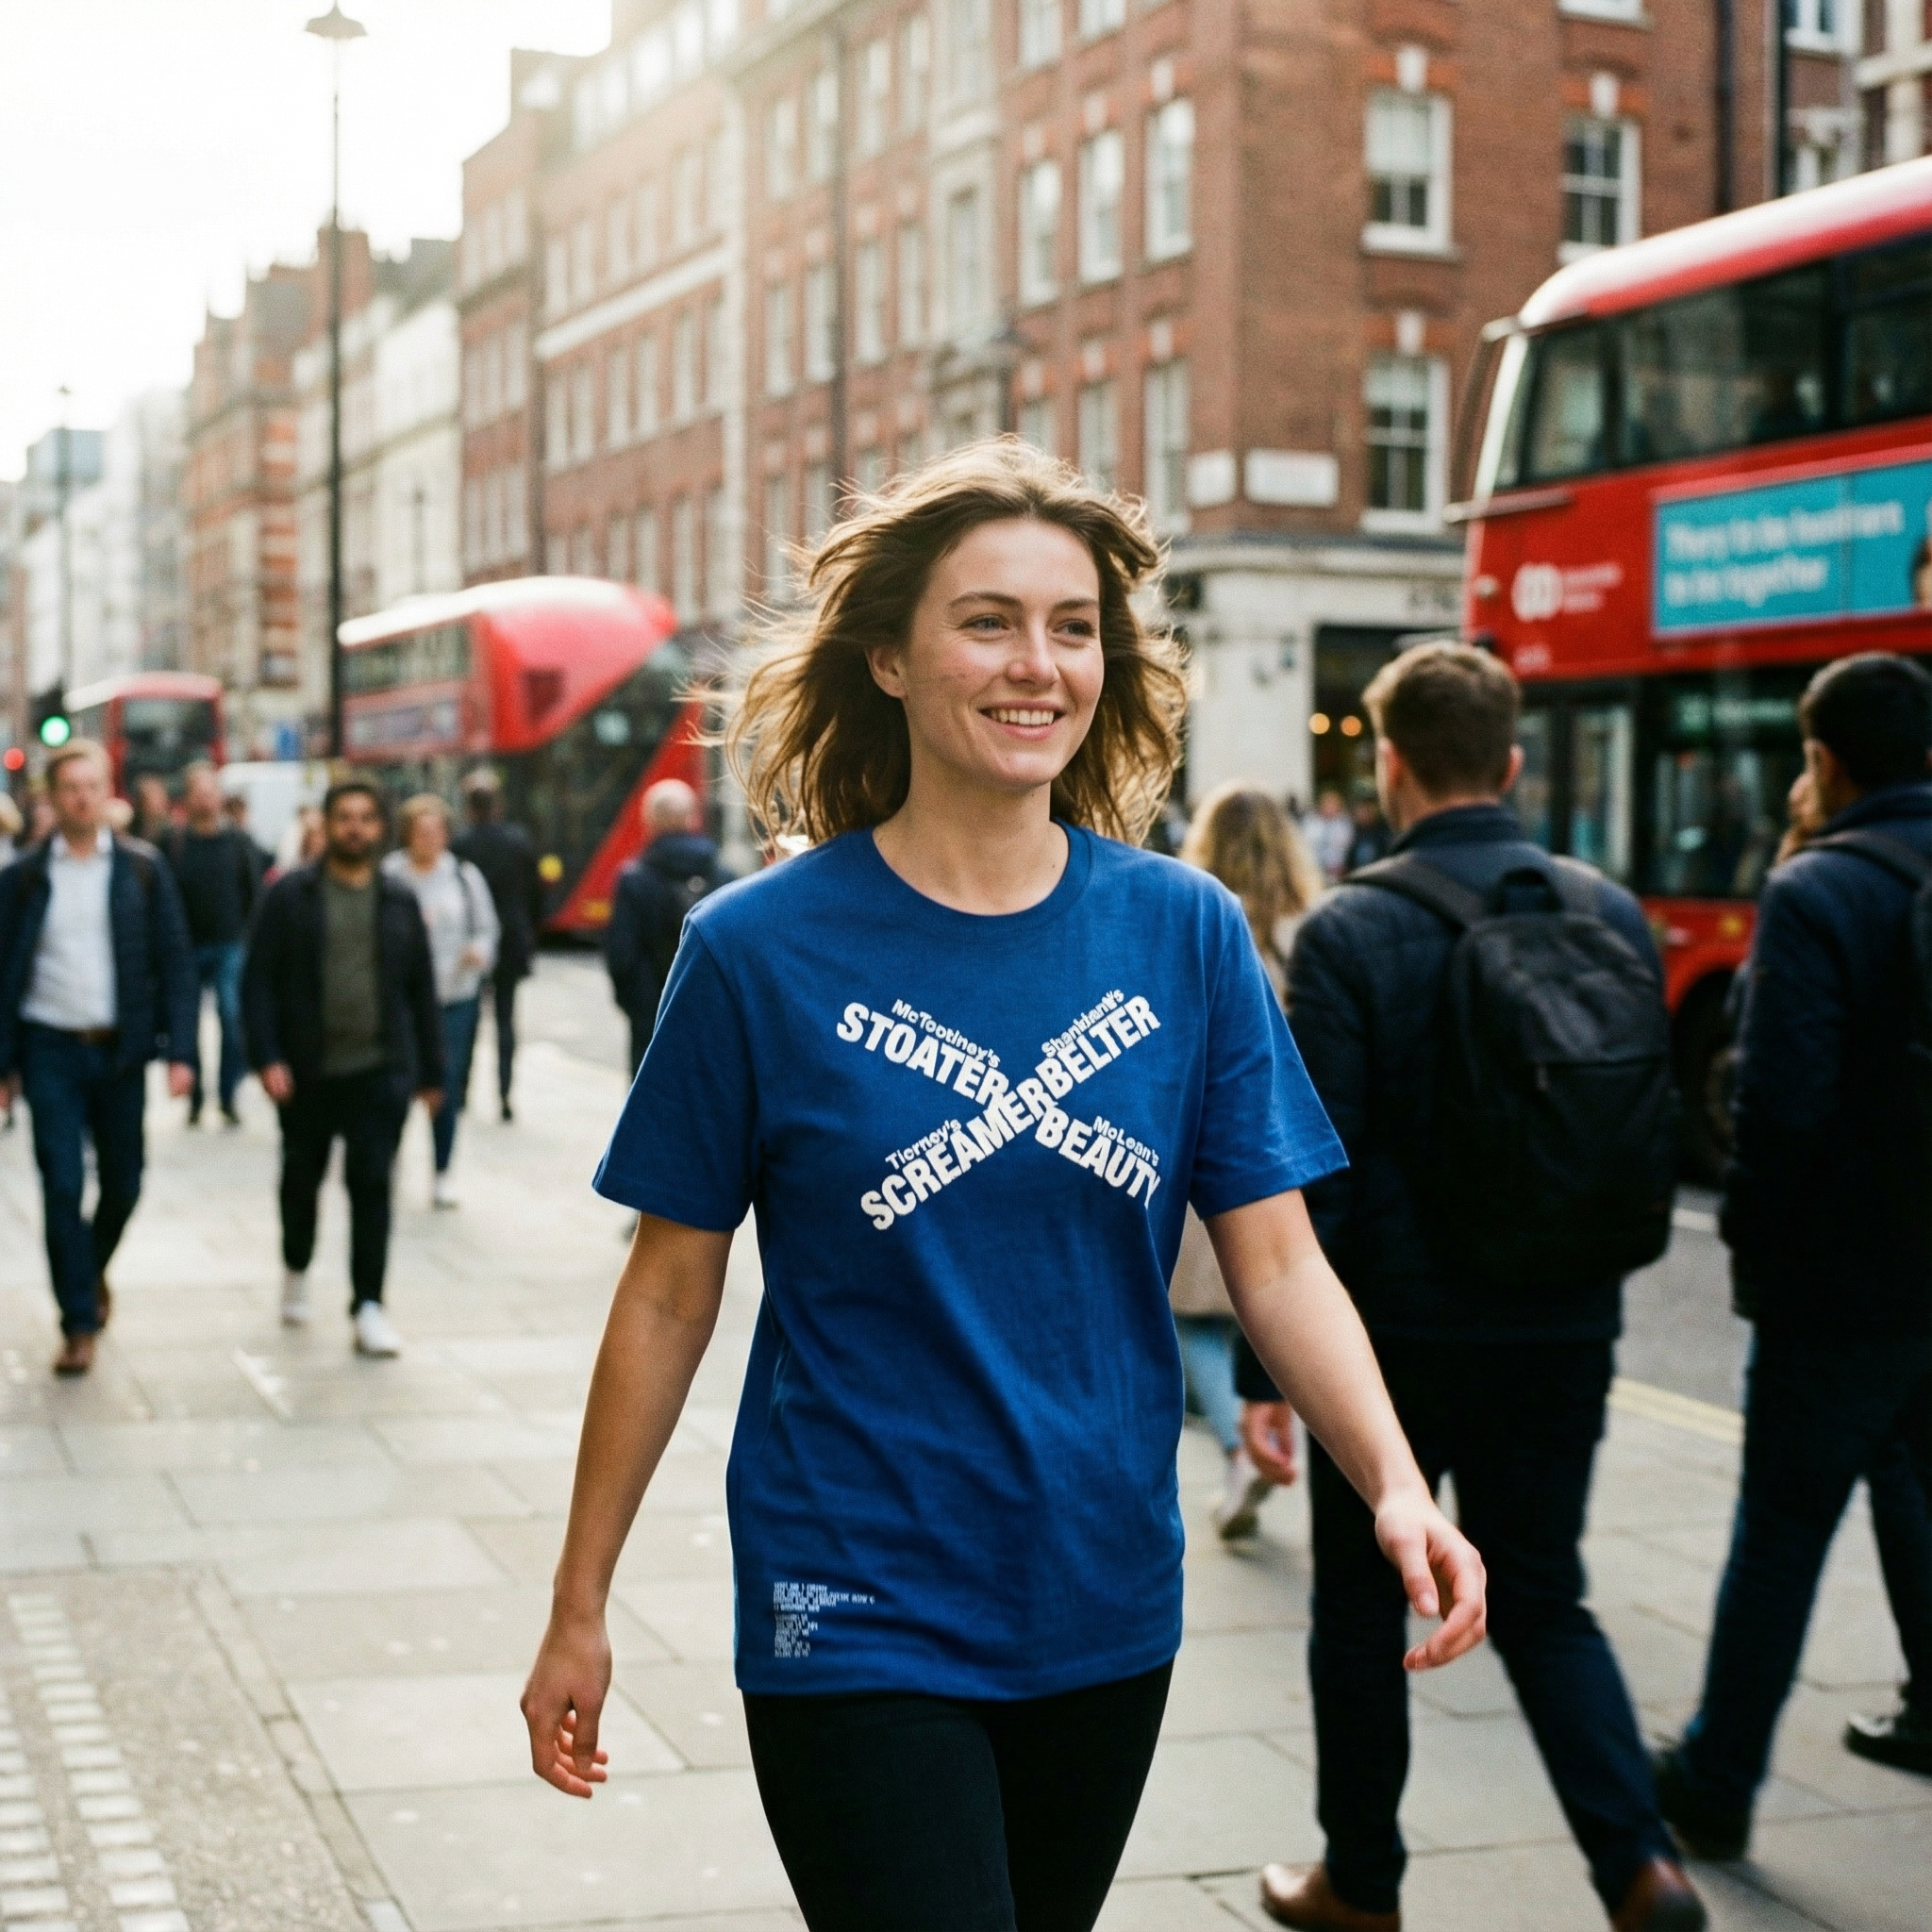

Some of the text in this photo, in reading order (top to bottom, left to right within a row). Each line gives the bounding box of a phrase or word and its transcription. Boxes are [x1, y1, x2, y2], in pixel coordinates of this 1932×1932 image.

[837, 1002, 1009, 1109] STOATER
[1035, 995, 1161, 1099] BELTER
[860, 1077, 1058, 1230] SCREAMER
[1035, 1107, 1161, 1210] BEAUTY
